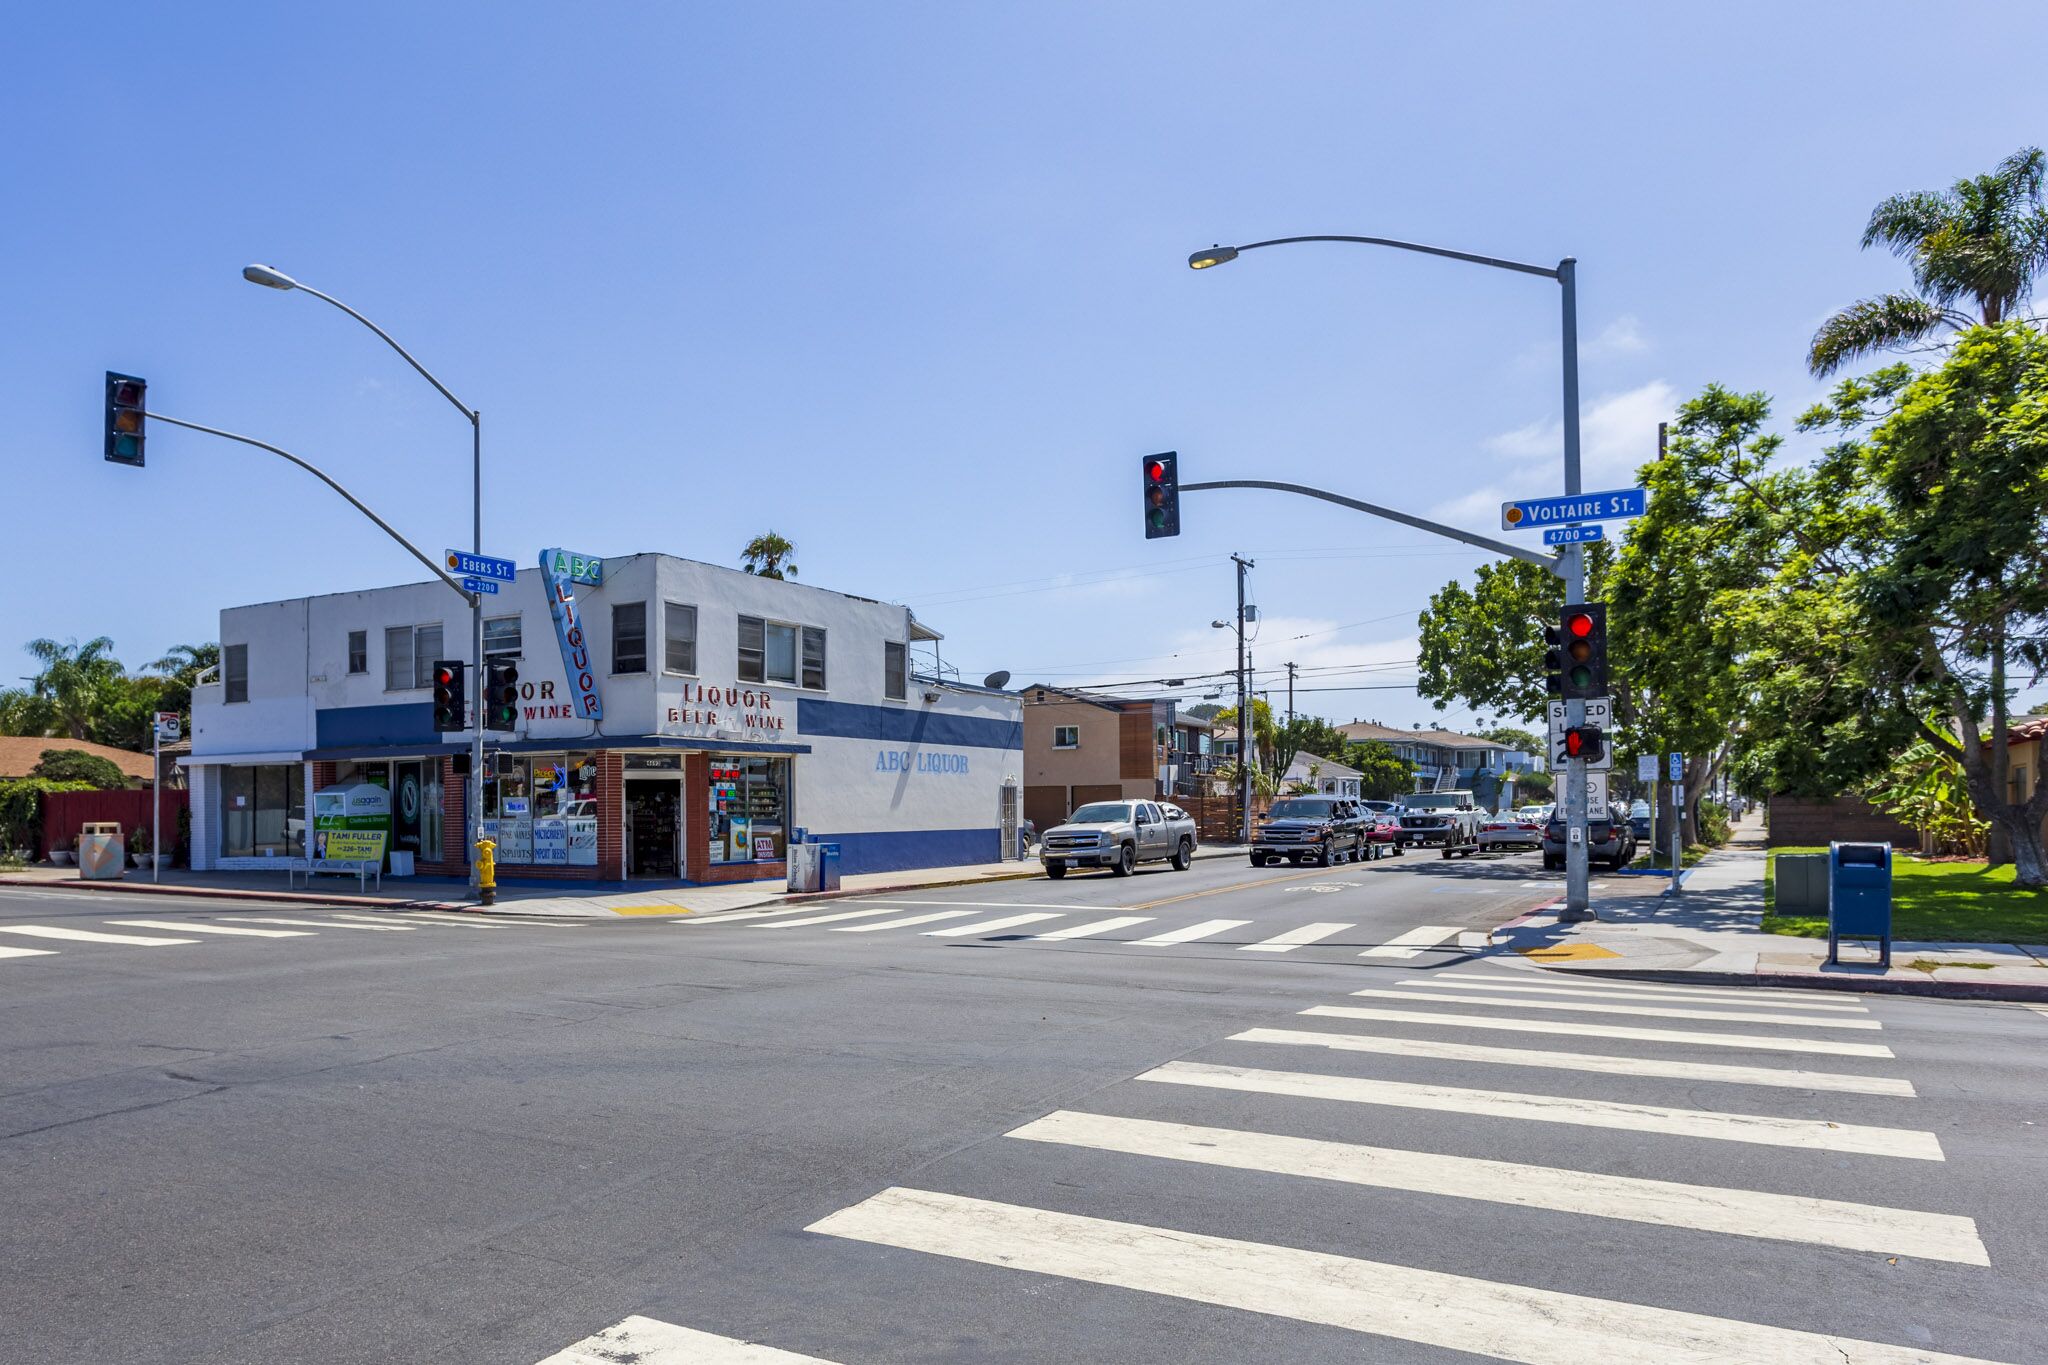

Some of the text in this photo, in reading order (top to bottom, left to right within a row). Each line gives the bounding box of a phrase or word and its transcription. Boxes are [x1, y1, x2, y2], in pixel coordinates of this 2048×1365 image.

[1528, 501, 1602, 522] VOLTAIRE
[1549, 529, 1580, 543] 4700
[462, 557, 492, 574] EBERS
[553, 552, 601, 580] ABC
[477, 583, 495, 593] 2200
[555, 582, 599, 717] LIQUOR
[683, 683, 772, 710] LIQUOR
[523, 704, 572, 720] WINE
[668, 707, 786, 731] BEER WINE
[1553, 704, 1606, 718] SED
[875, 750, 970, 775] ABC LIQUOR
[331, 832, 382, 841] TAMI FULLER
[756, 839, 774, 850] ATM
